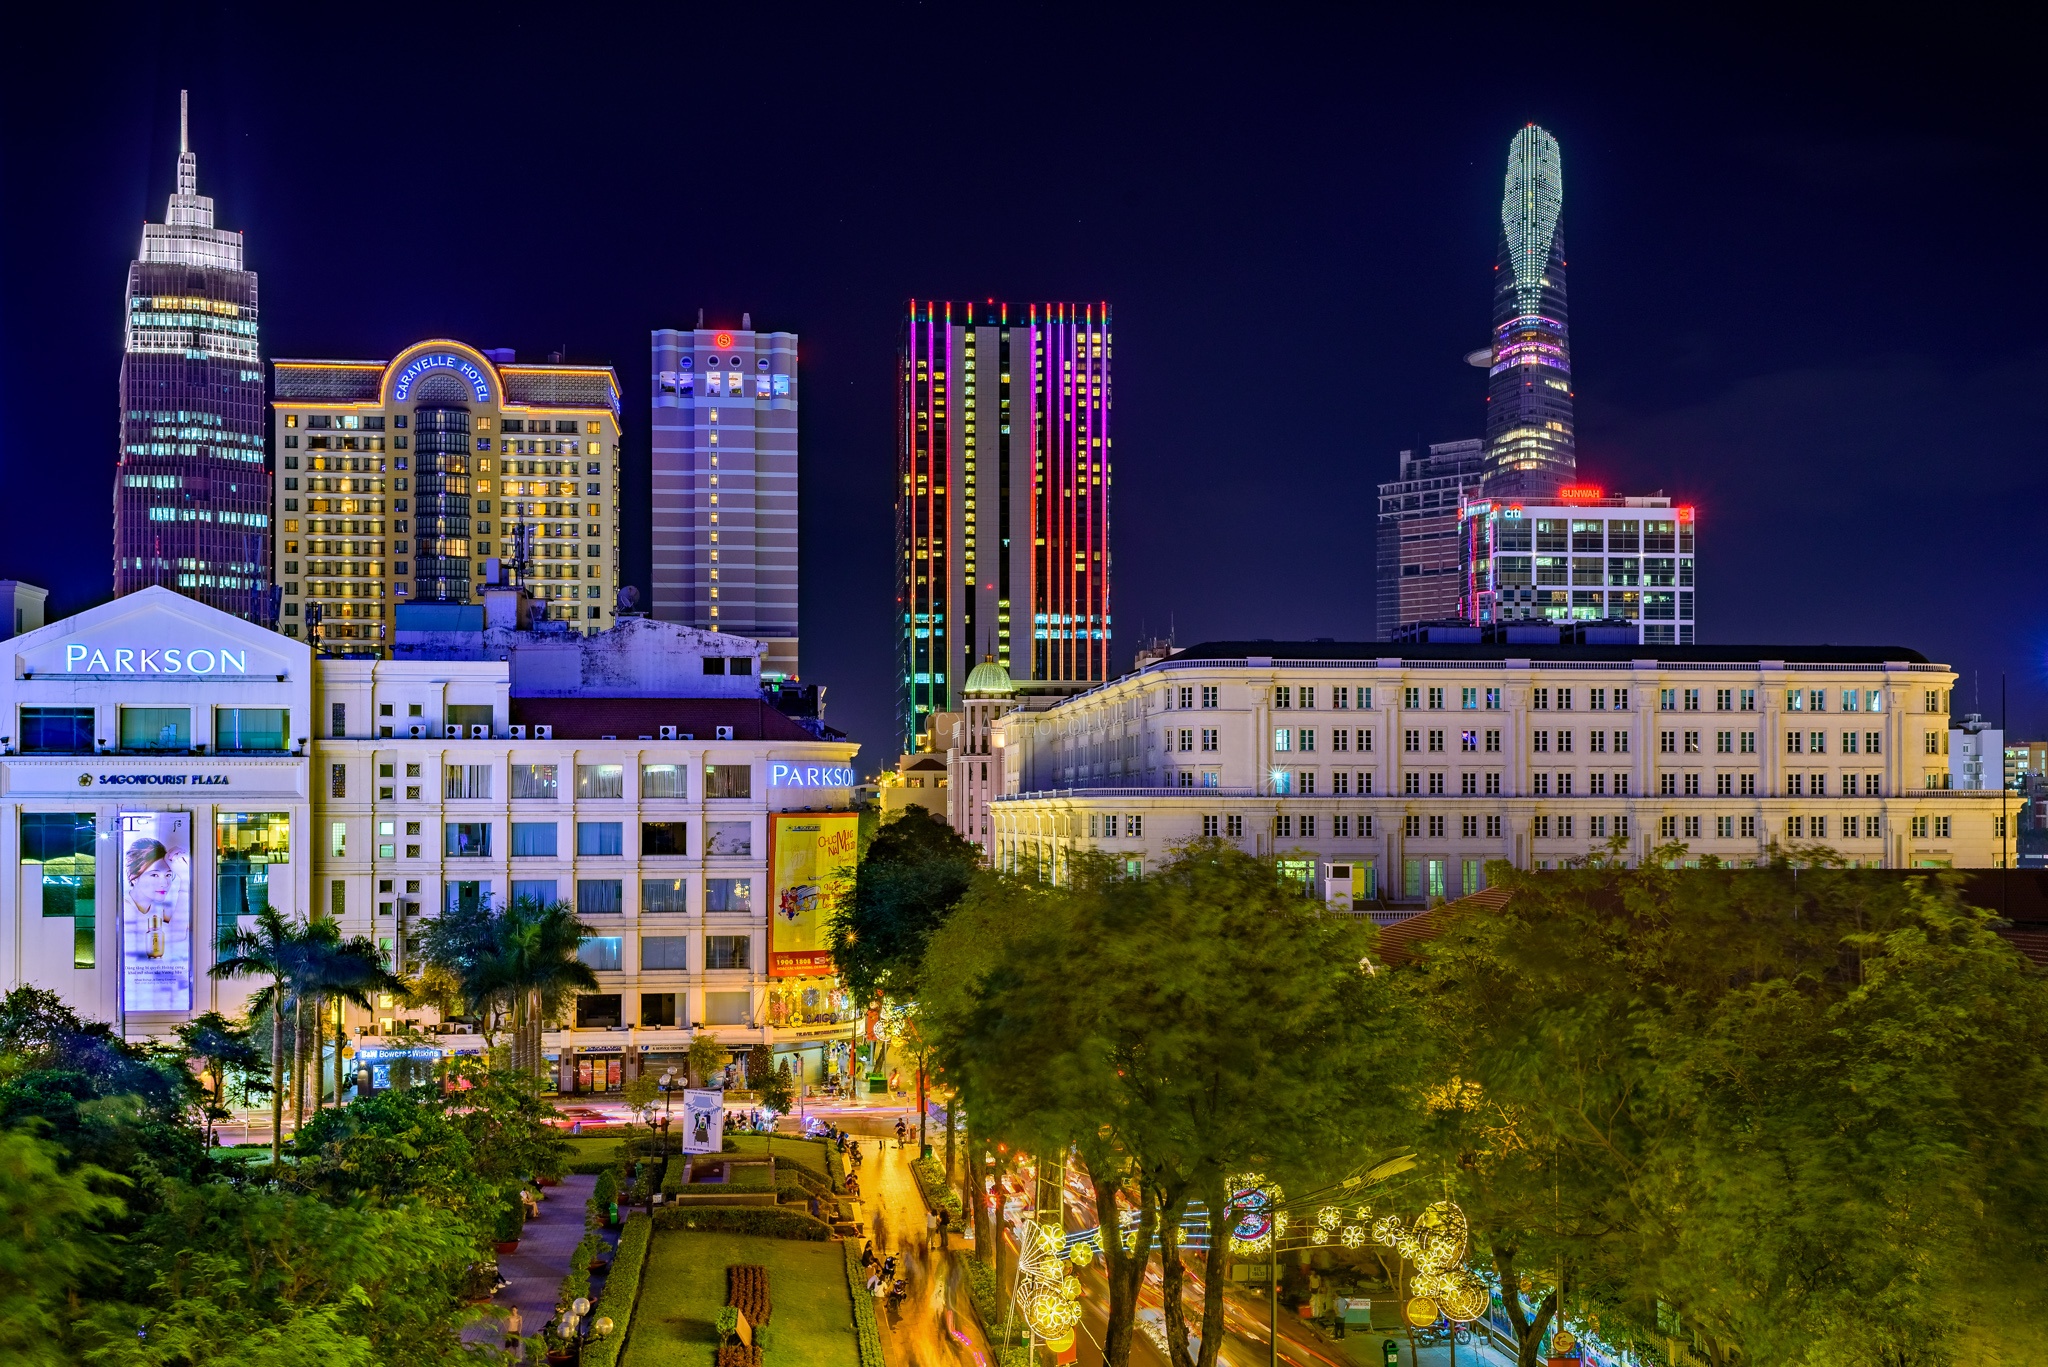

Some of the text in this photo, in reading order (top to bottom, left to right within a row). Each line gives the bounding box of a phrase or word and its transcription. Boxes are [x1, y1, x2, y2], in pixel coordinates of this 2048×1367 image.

[396, 356, 488, 402] CARAVELLE HOTEL
[1561, 489, 1600, 498] SUNWAH
[1504, 508, 1521, 519] citi
[66, 644, 246, 674] PARKSON
[99, 774, 230, 785] SAIGONTOURIST PLAZA
